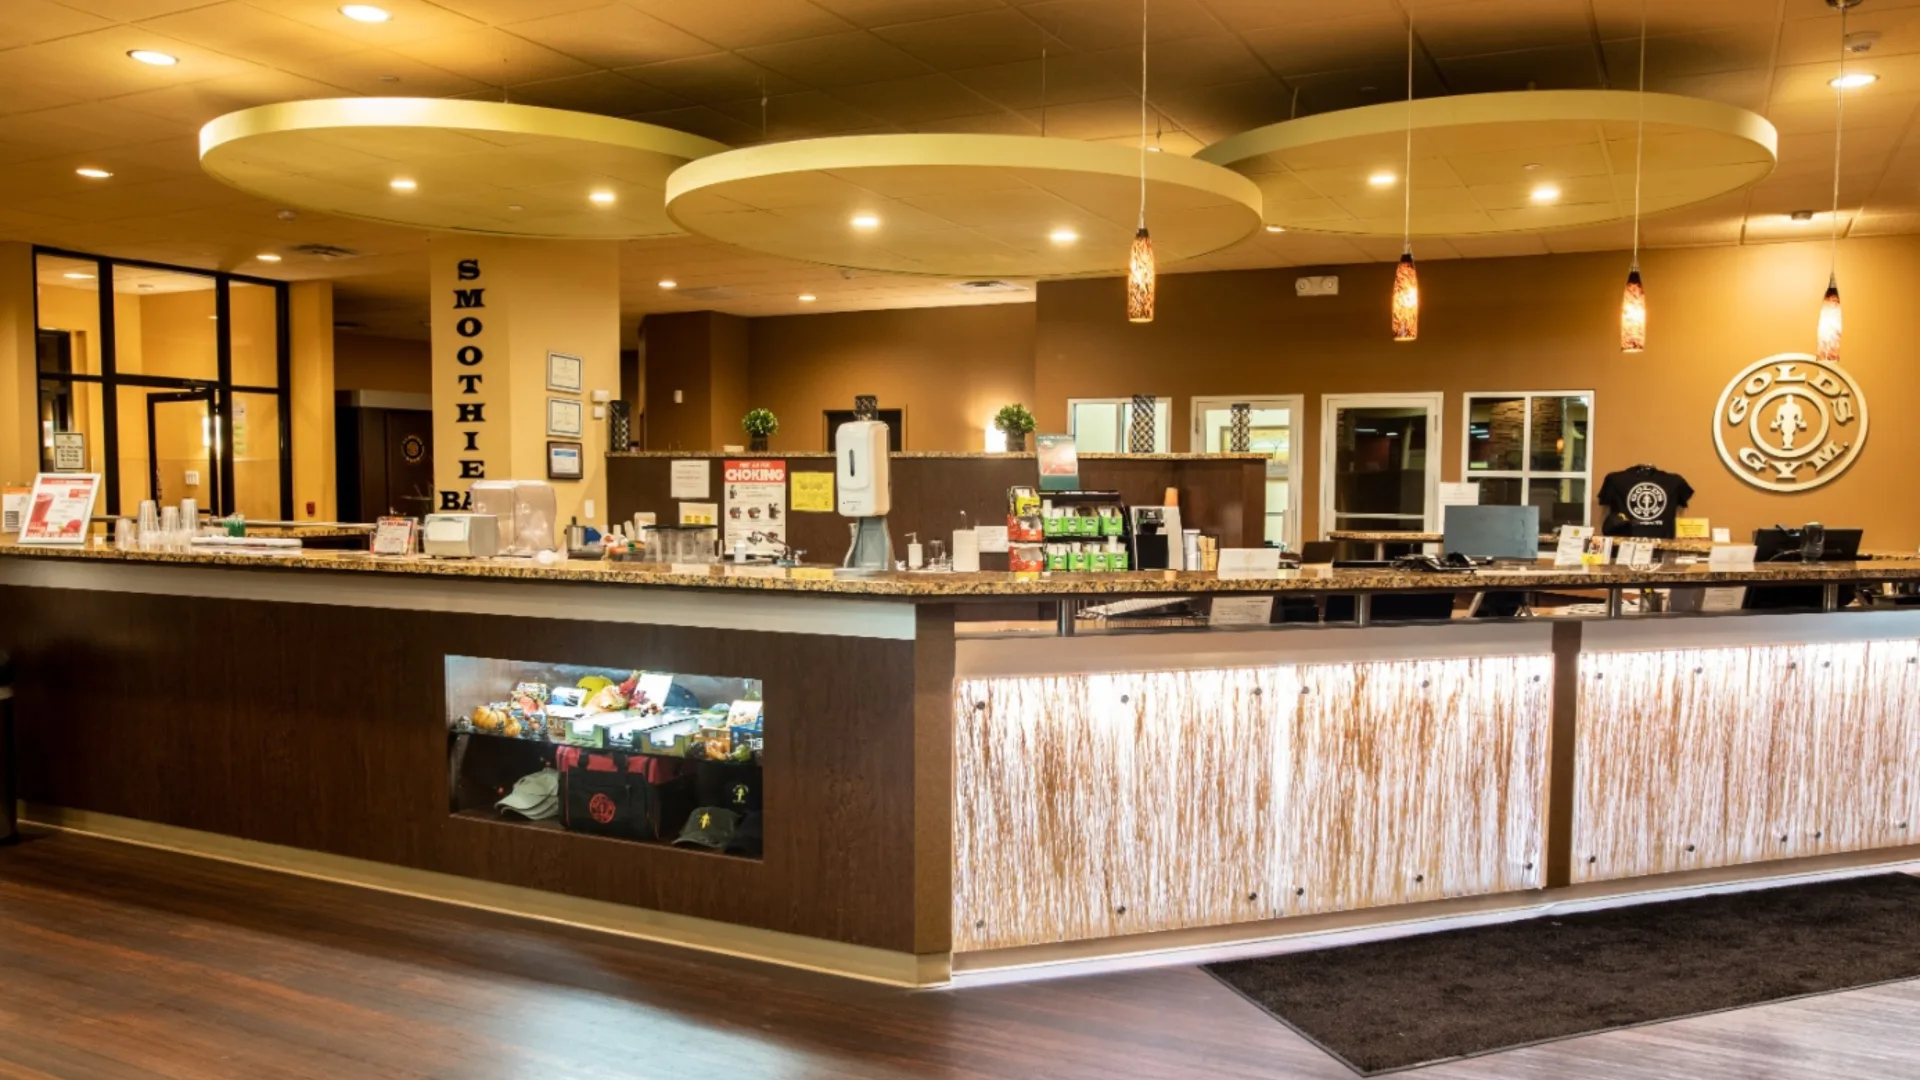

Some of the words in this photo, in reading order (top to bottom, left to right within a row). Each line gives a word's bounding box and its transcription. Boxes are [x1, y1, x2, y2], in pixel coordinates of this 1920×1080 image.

[453, 258, 486, 479] SMOOTHIE
[1728, 364, 1855, 425] GOLD'S
[725, 468, 785, 481] CHOKING
